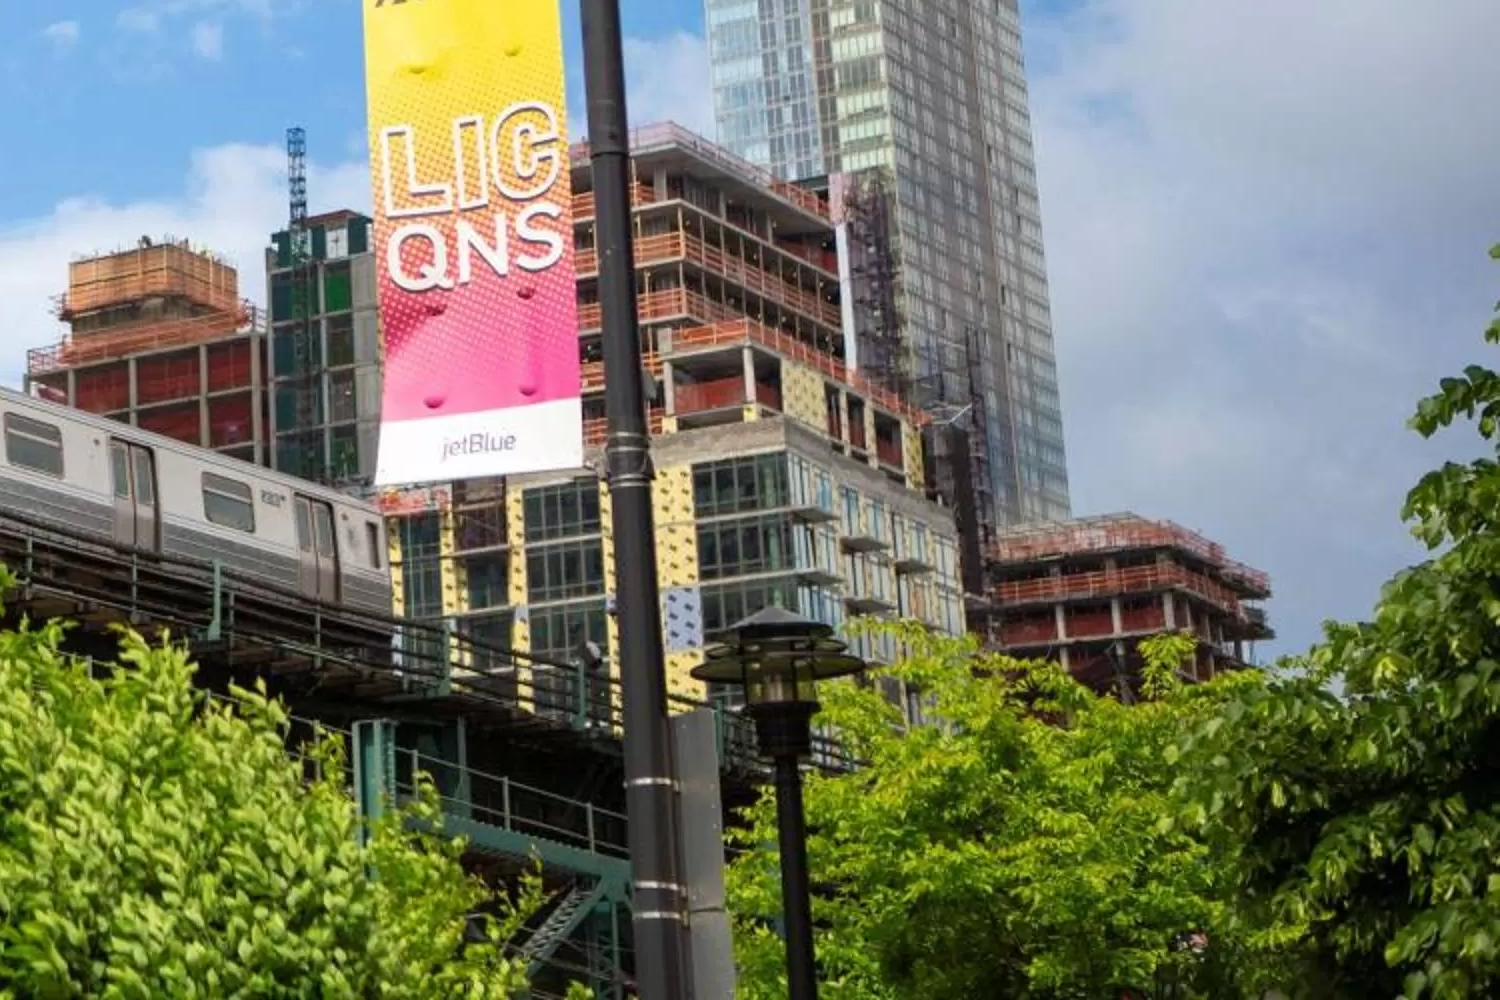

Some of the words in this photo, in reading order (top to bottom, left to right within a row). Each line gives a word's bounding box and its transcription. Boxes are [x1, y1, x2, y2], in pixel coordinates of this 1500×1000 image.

[382, 102, 559, 218] LIC
[388, 202, 564, 291] QNS
[441, 431, 518, 462] jetBlue
